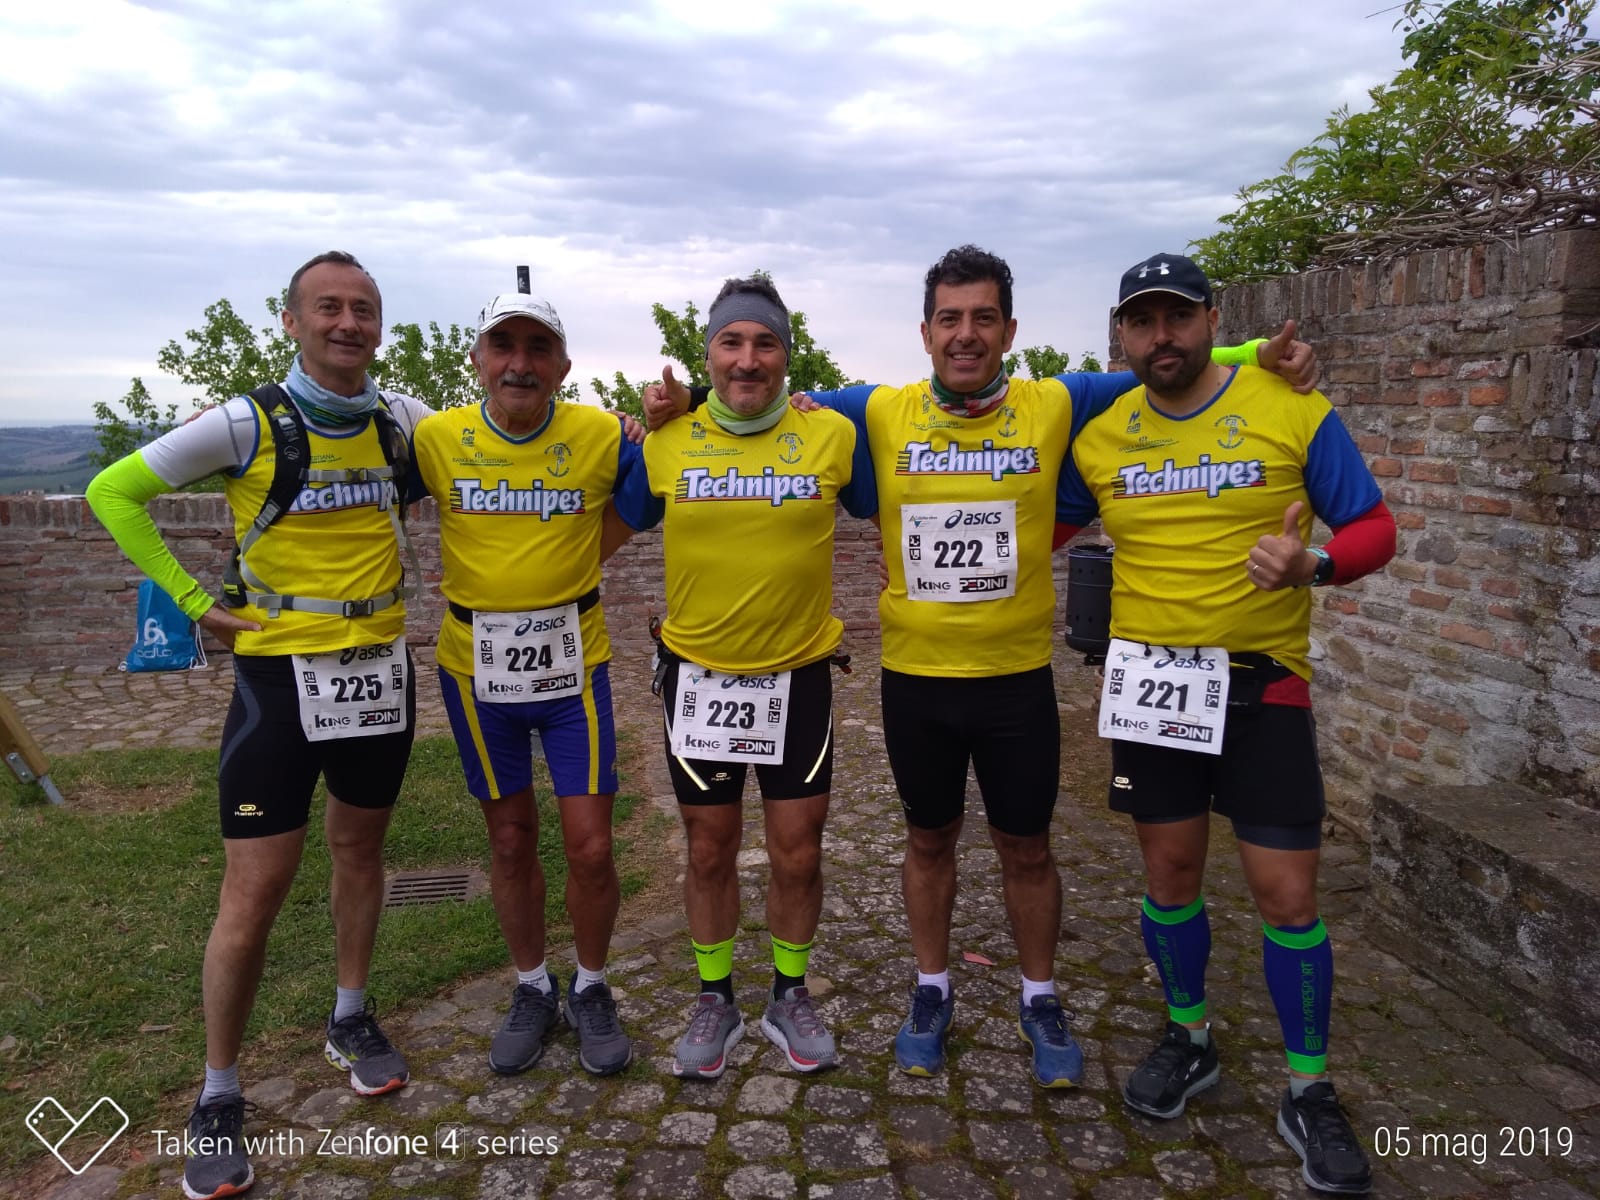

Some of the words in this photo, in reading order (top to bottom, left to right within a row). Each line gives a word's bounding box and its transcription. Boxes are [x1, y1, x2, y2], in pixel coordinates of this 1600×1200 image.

[905, 439, 1036, 481] Technipes
[682, 466, 818, 507] Technipes
[1118, 454, 1262, 498] Technipes
[289, 479, 398, 512] echnip
[453, 478, 583, 522] Technipes
[964, 512, 1001, 525] asics
[934, 540, 983, 568] 222
[960, 577, 1006, 592] PEDINI
[533, 616, 566, 632] asics
[506, 644, 553, 672] 224
[331, 674, 382, 703] 225
[532, 676, 576, 692] PEDINI
[1136, 678, 1188, 712] 221
[359, 710, 399, 726] PEDINI
[706, 700, 755, 729] 223
[1159, 723, 1212, 741] PEDINI
[729, 740, 774, 754] PEDINI
[1301, 960, 1315, 1035] CMPRESSPRT
